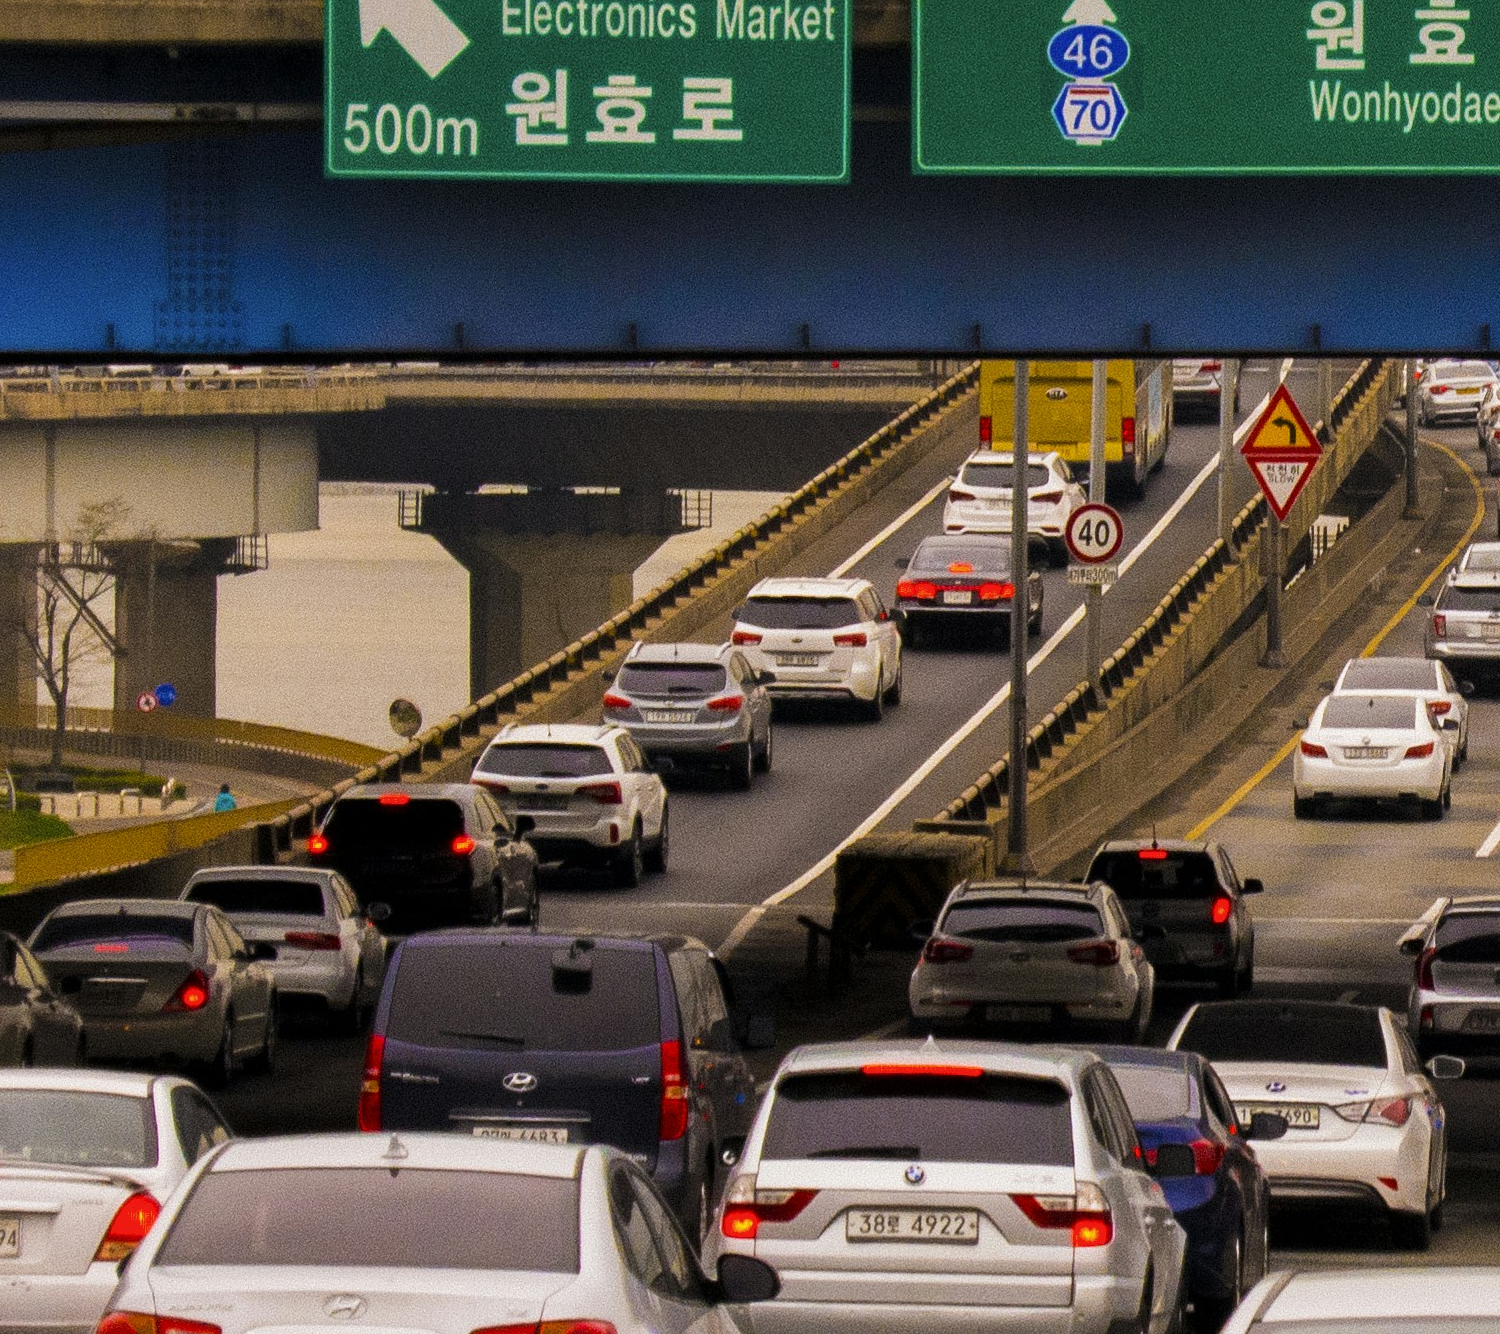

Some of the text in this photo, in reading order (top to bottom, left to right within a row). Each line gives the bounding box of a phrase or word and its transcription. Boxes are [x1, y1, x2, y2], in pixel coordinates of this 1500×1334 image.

[1062, 33, 1113, 70] 46
[506, 69, 743, 145] 원효로
[1069, 99, 1111, 131] 70
[344, 103, 478, 156] 500m
[1078, 518, 1110, 547] 40
[911, 1214, 966, 1236] 4922
